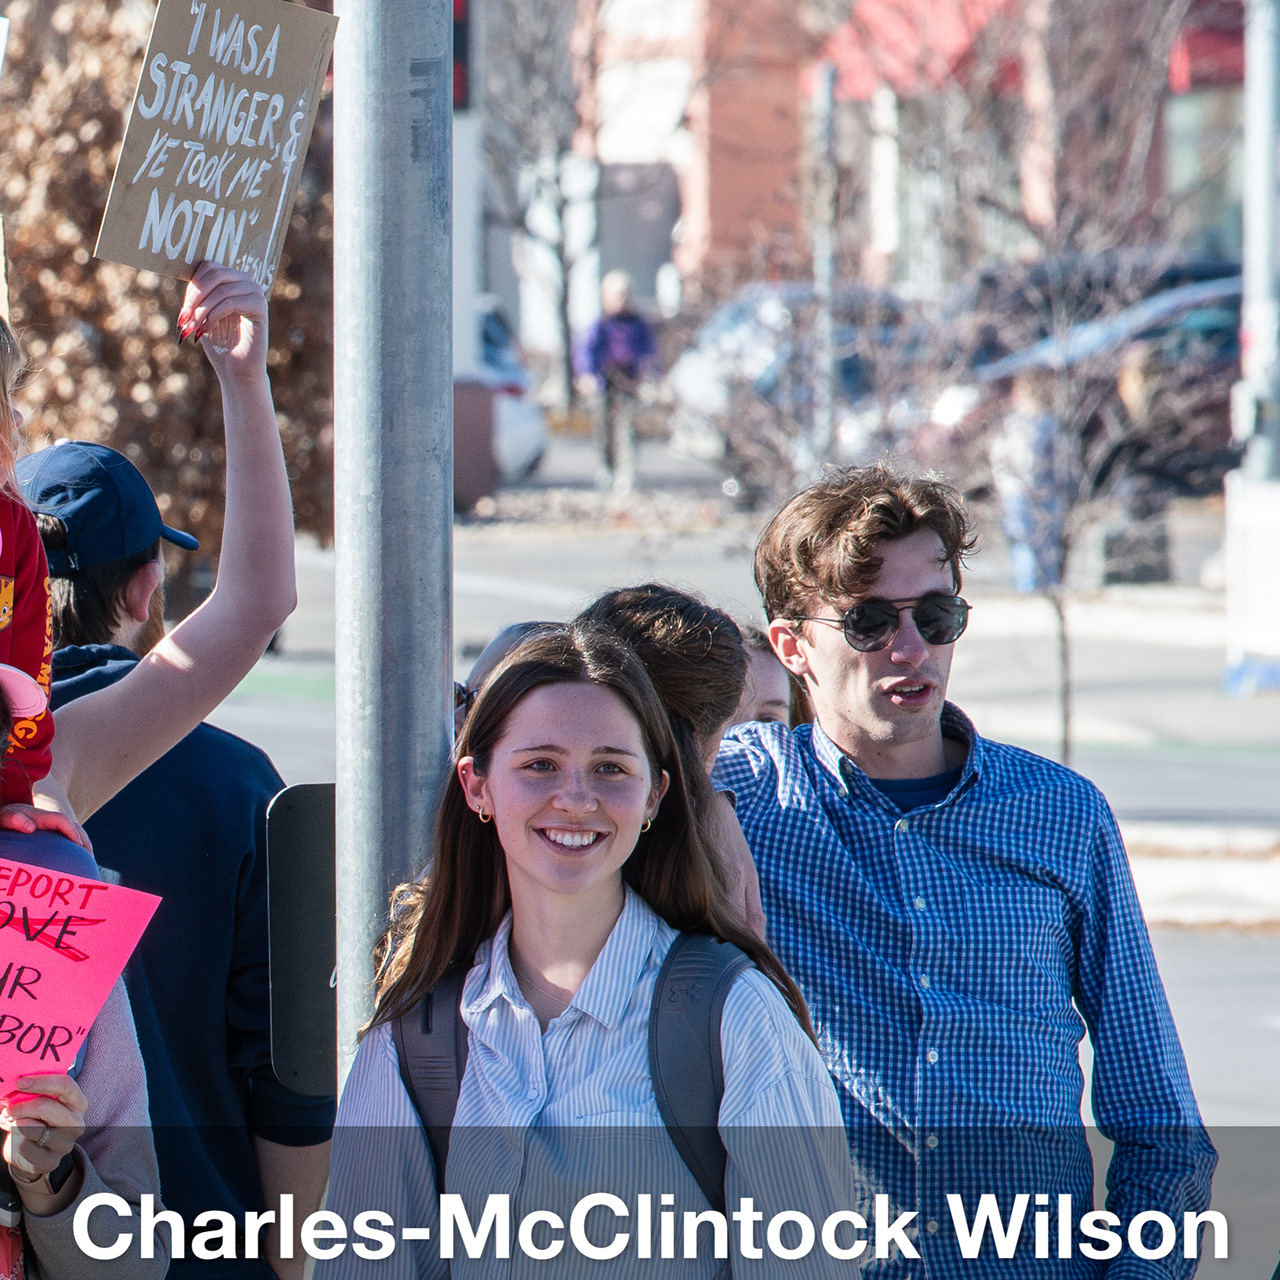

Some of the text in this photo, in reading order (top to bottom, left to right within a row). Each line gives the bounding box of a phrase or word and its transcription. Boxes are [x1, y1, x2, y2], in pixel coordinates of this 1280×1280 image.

[209, 8, 263, 75] WAS
[255, 23, 280, 79] A
[132, 128, 272, 201] YE TOOK ME
[138, 187, 217, 265] NOT
